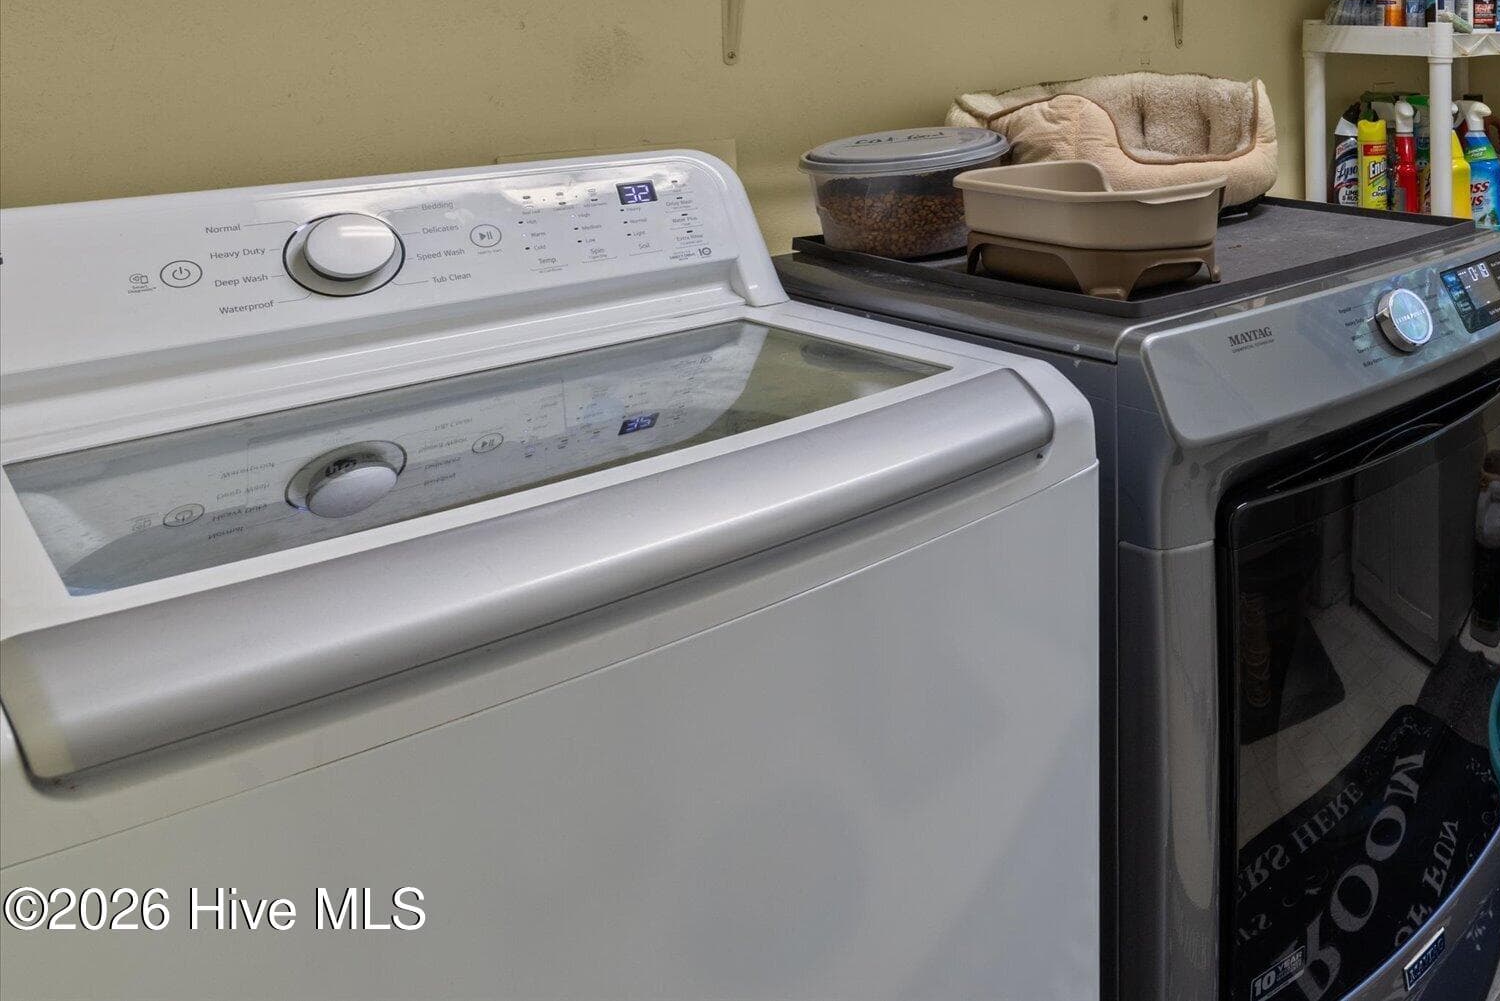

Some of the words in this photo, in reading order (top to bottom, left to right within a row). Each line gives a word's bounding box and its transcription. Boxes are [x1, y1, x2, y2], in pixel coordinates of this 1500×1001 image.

[1336, 162, 1358, 181] Lyso
[624, 184, 650, 204] 32
[421, 201, 454, 211] Bedding
[205, 224, 242, 234] Normal
[422, 224, 460, 235] Delicates
[210, 250, 240, 261] Heavy
[242, 247, 266, 258] Duty
[416, 251, 442, 262] Speed
[443, 247, 465, 256] Wash
[214, 278, 240, 289] Deep
[242, 273, 269, 284] Wash
[432, 275, 447, 284] Tub
[448, 272, 472, 281] Clean
[219, 300, 275, 315] Waterproof
[1228, 326, 1272, 347] MAYTAG
[1254, 969, 1276, 997] 10
